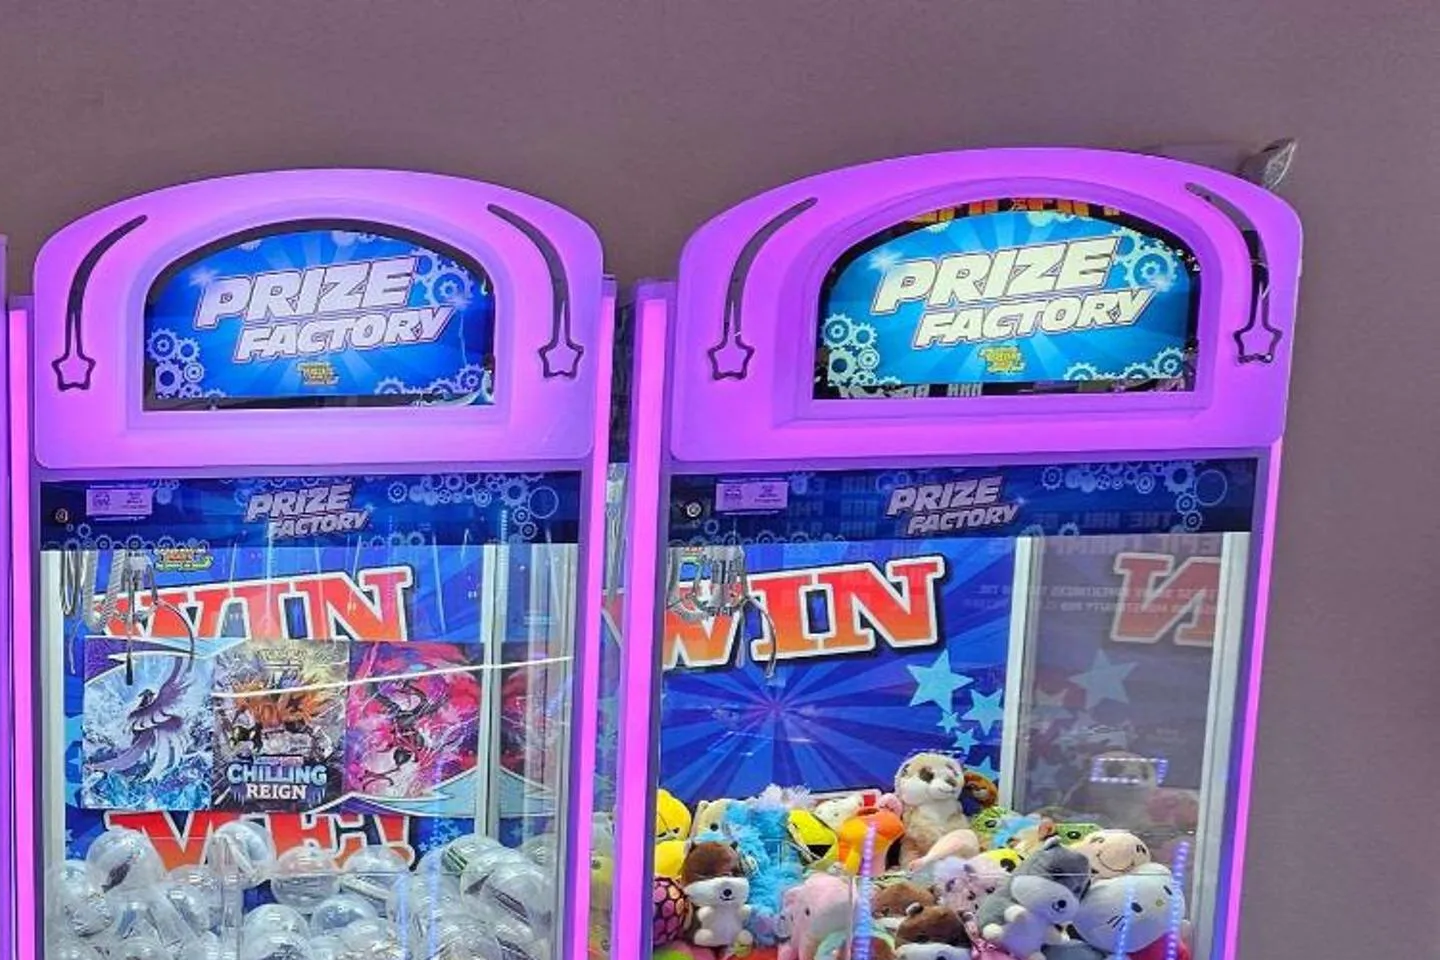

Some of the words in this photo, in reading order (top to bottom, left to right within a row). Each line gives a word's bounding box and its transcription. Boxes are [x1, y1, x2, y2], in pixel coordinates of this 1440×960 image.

[195, 256, 416, 328] PRIZE
[871, 236, 1120, 315] PRIZE
[233, 306, 455, 363] FACTORY
[912, 287, 1157, 350] FACTORY
[245, 484, 353, 522] PRIZE
[885, 476, 1004, 516] PRIZE
[268, 510, 369, 540] FACTORY
[907, 505, 1020, 535] FACTORY
[227, 763, 328, 786] CHILLING
[246, 784, 308, 800] REIGN
